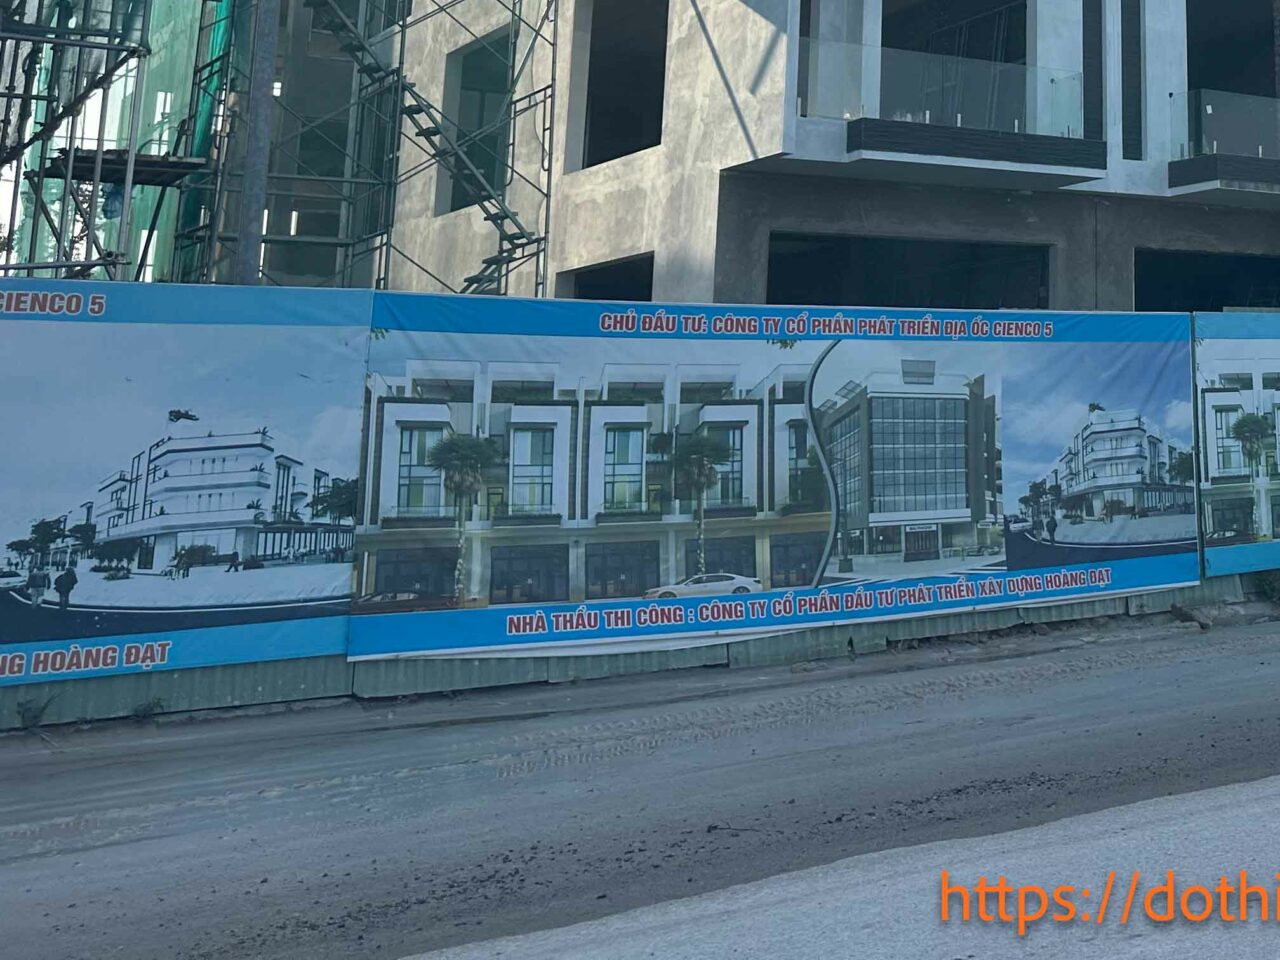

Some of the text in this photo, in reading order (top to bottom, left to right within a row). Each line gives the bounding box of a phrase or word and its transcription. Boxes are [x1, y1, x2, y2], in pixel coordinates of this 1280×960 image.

[0, 290, 106, 316] IENCO 5
[600, 309, 1054, 340] CHỦ ĐẦU TƯ: CÔNG TY CỔ PHẦN PHÁT TRIỂN ĐỊA ỐC CIENCO 5
[507, 610, 547, 635] NHÀ
[552, 605, 599, 632] THẦU
[603, 607, 632, 629] THI
[637, 603, 684, 626] CÔNG
[698, 598, 744, 622] CÔNG
[749, 600, 768, 619] TY
[772, 592, 795, 616] CỔ
[797, 589, 841, 614] PHẦN
[844, 585, 873, 610] ĐẦU
[877, 587, 896, 607] TƯ
[899, 582, 934, 606] PHÁT
[936, 576, 977, 601] TRIỂN
[979, 576, 1005, 597] XÂY
[1007, 574, 1043, 598] DỰNG
[1044, 569, 1087, 591] HOÀNG
[1089, 567, 1112, 588] ĐẠT
[31, 643, 119, 675] HOÀNG
[123, 640, 172, 670] ĐẠT
